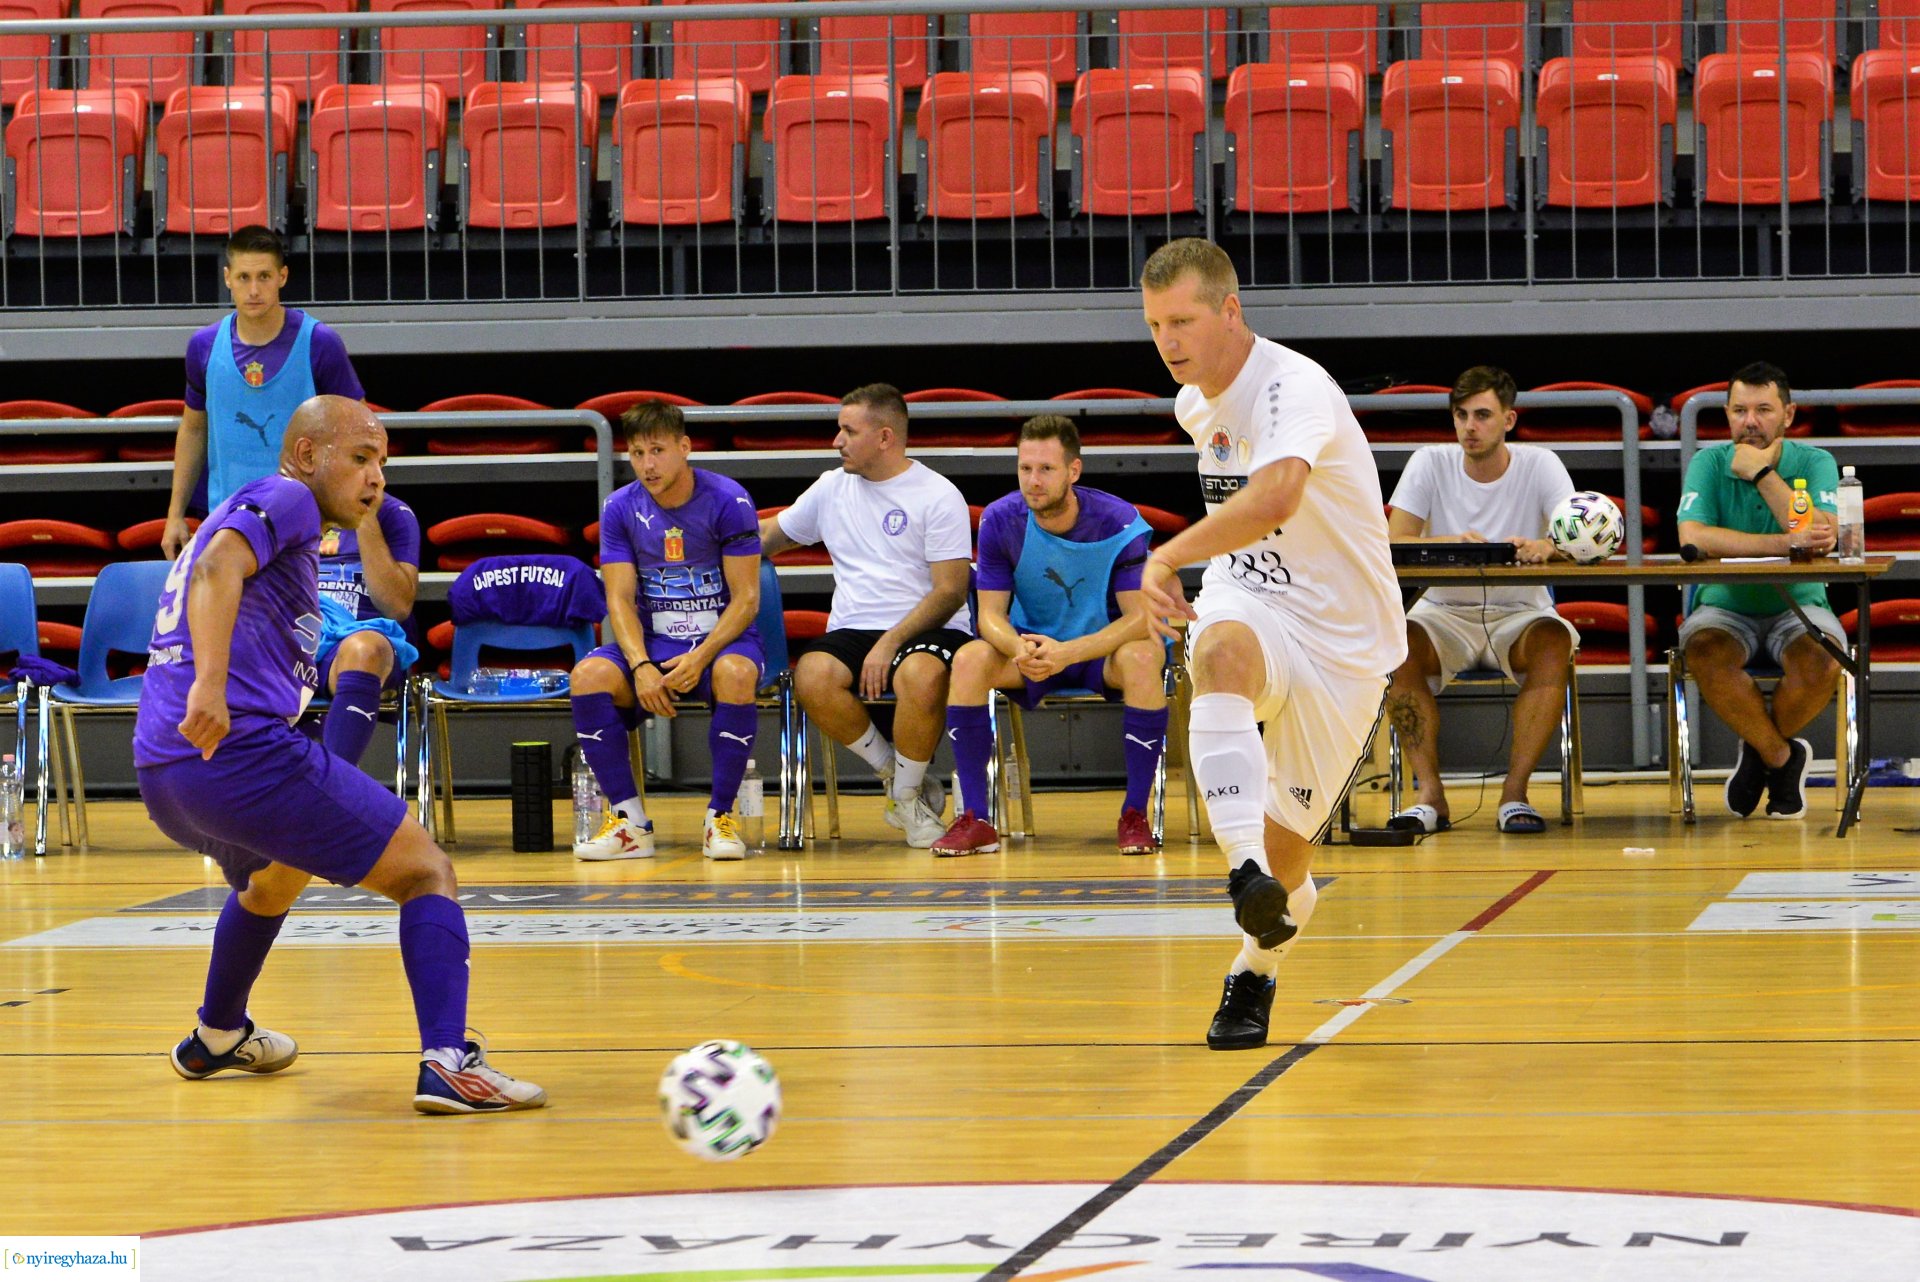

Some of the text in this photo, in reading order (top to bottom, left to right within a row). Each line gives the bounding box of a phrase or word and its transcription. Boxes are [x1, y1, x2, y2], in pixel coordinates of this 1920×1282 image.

[473, 566, 565, 590] ÚJPEST FUTSAL
[698, 583, 720, 594] VOLT
[667, 624, 702, 634] VIOLA
[1206, 785, 1240, 801] AKO
[391, 1231, 1749, 1255] NYÍREGYHÁZA
